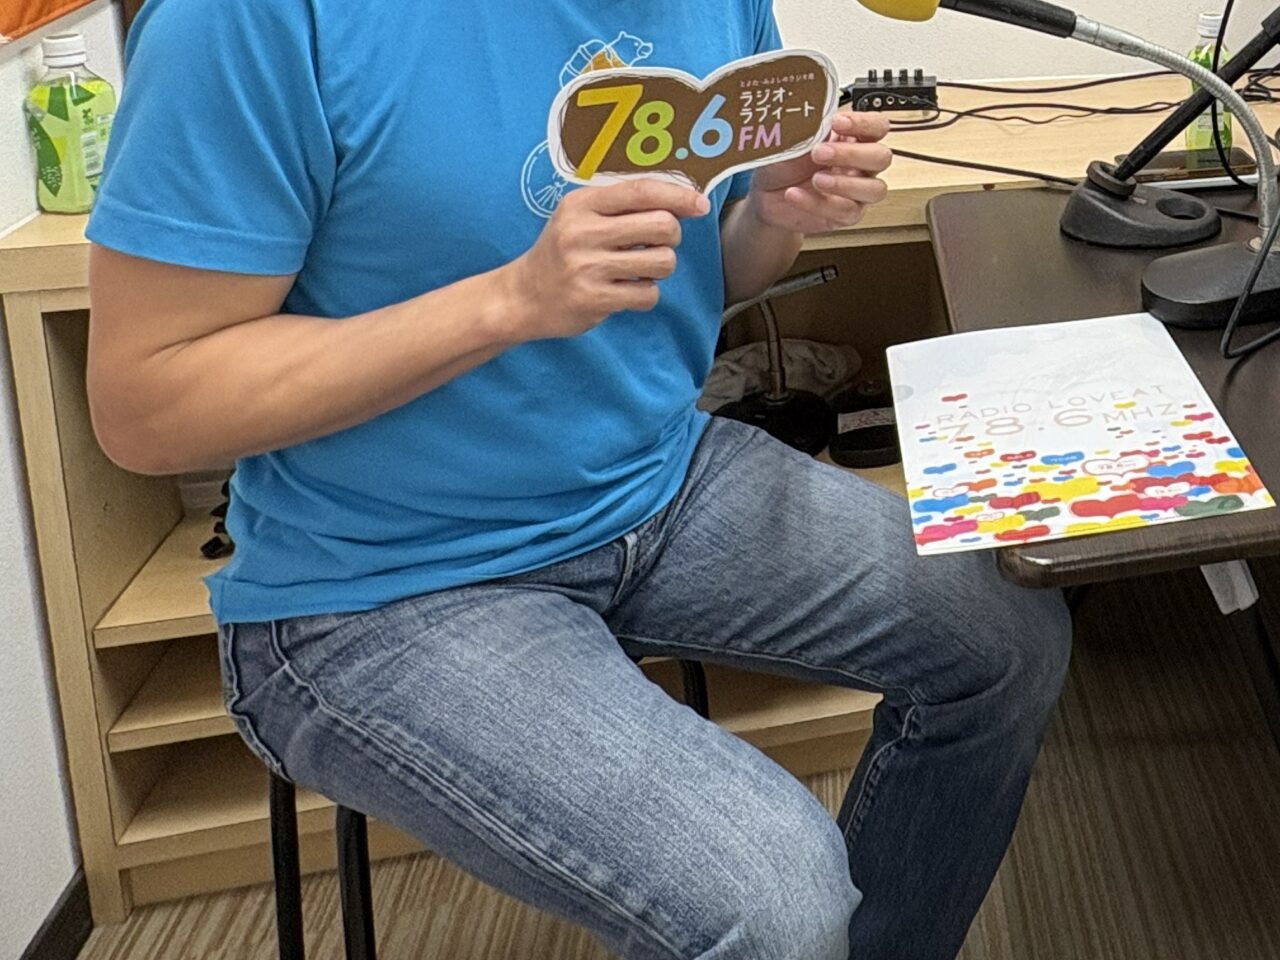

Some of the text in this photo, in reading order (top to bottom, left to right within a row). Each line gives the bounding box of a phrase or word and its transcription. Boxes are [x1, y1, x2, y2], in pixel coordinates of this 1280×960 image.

[575, 84, 734, 180] 78.6
[738, 122, 781, 151] FM
[937, 385, 1166, 424] RADIO LOVEAT
[939, 403, 1178, 443] 78.6 MHZ
